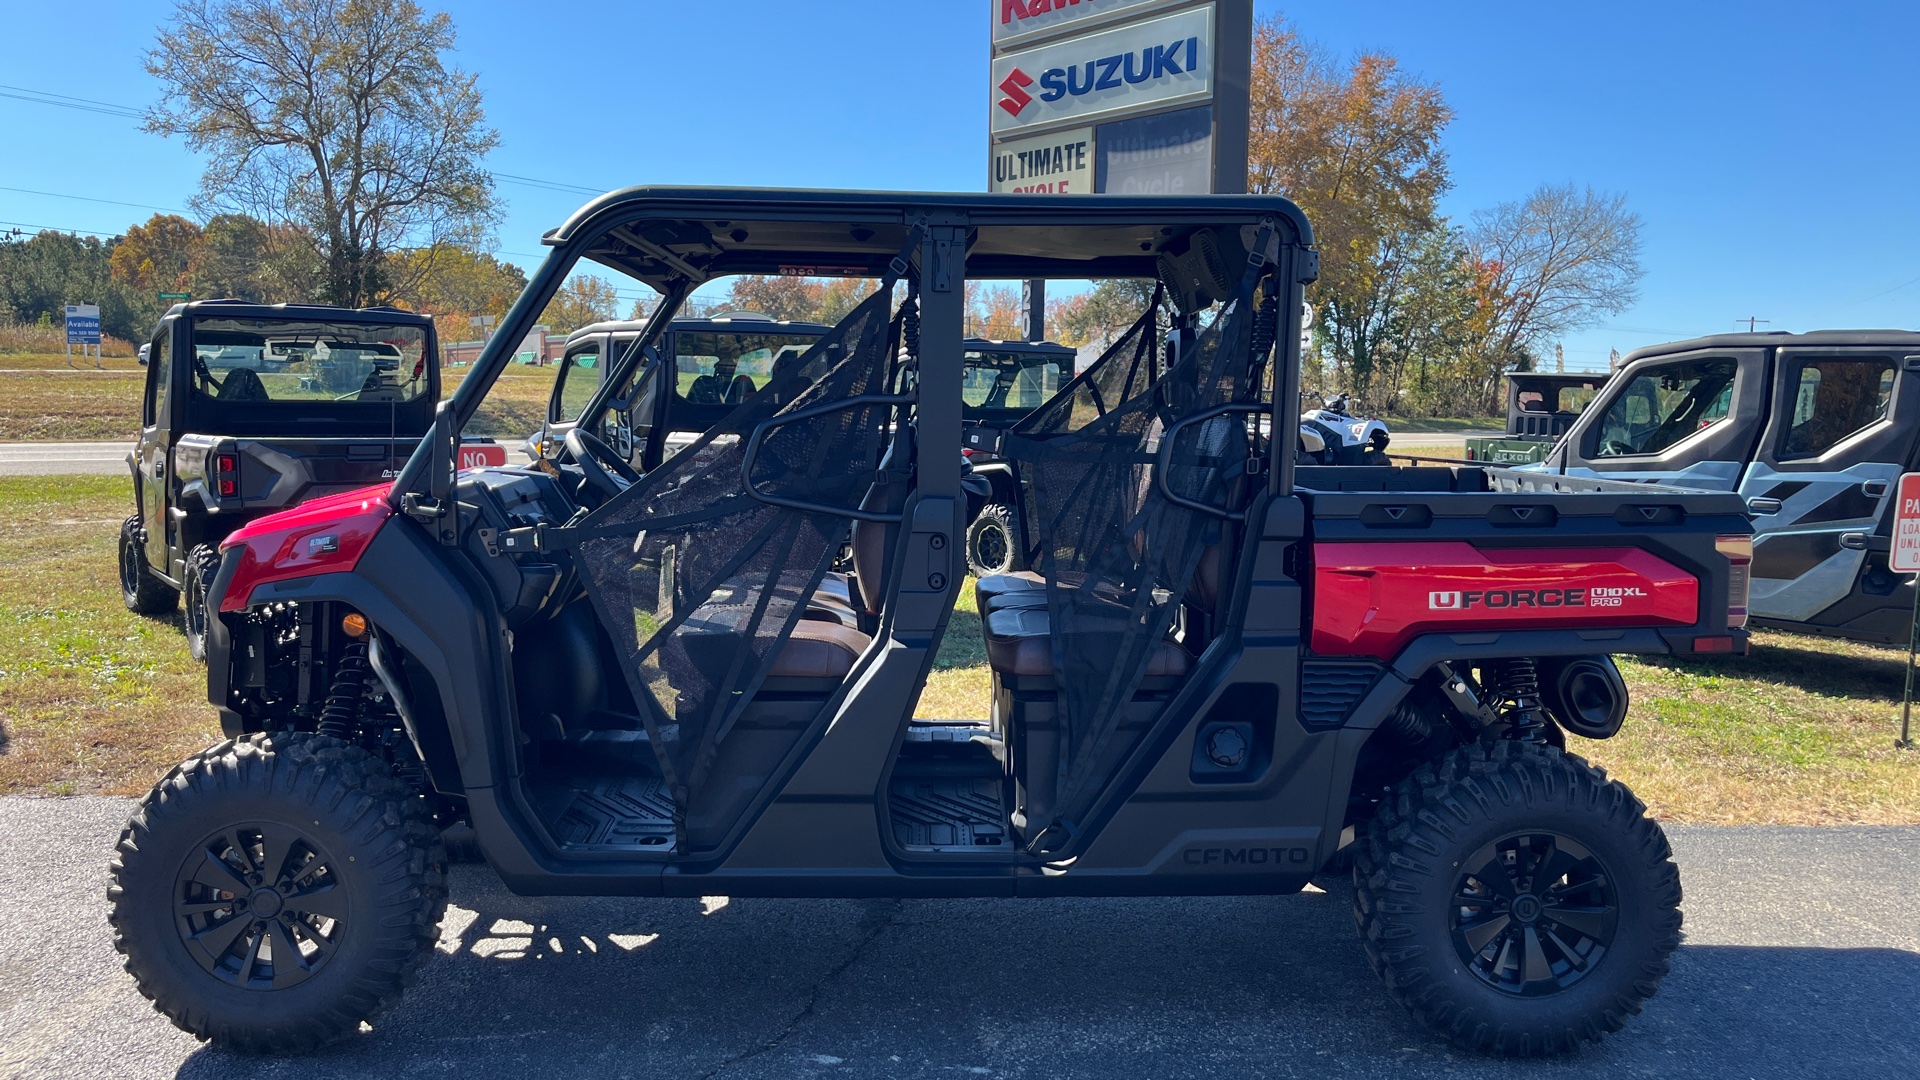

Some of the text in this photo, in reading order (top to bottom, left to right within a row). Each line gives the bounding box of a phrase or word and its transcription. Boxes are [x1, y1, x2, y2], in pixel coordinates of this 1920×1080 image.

[1039, 36, 1197, 102] SUZUKI
[1107, 127, 1206, 166] Ultimate
[995, 141, 1087, 182] ULTIMATE
[68, 320, 99, 328] Available
[463, 452, 487, 468] NO
[1494, 453, 1531, 461] ROXOR
[1901, 539, 1920, 549] UNL
[1591, 598, 1622, 606] PRO
[1183, 847, 1309, 865] CFMOTO
